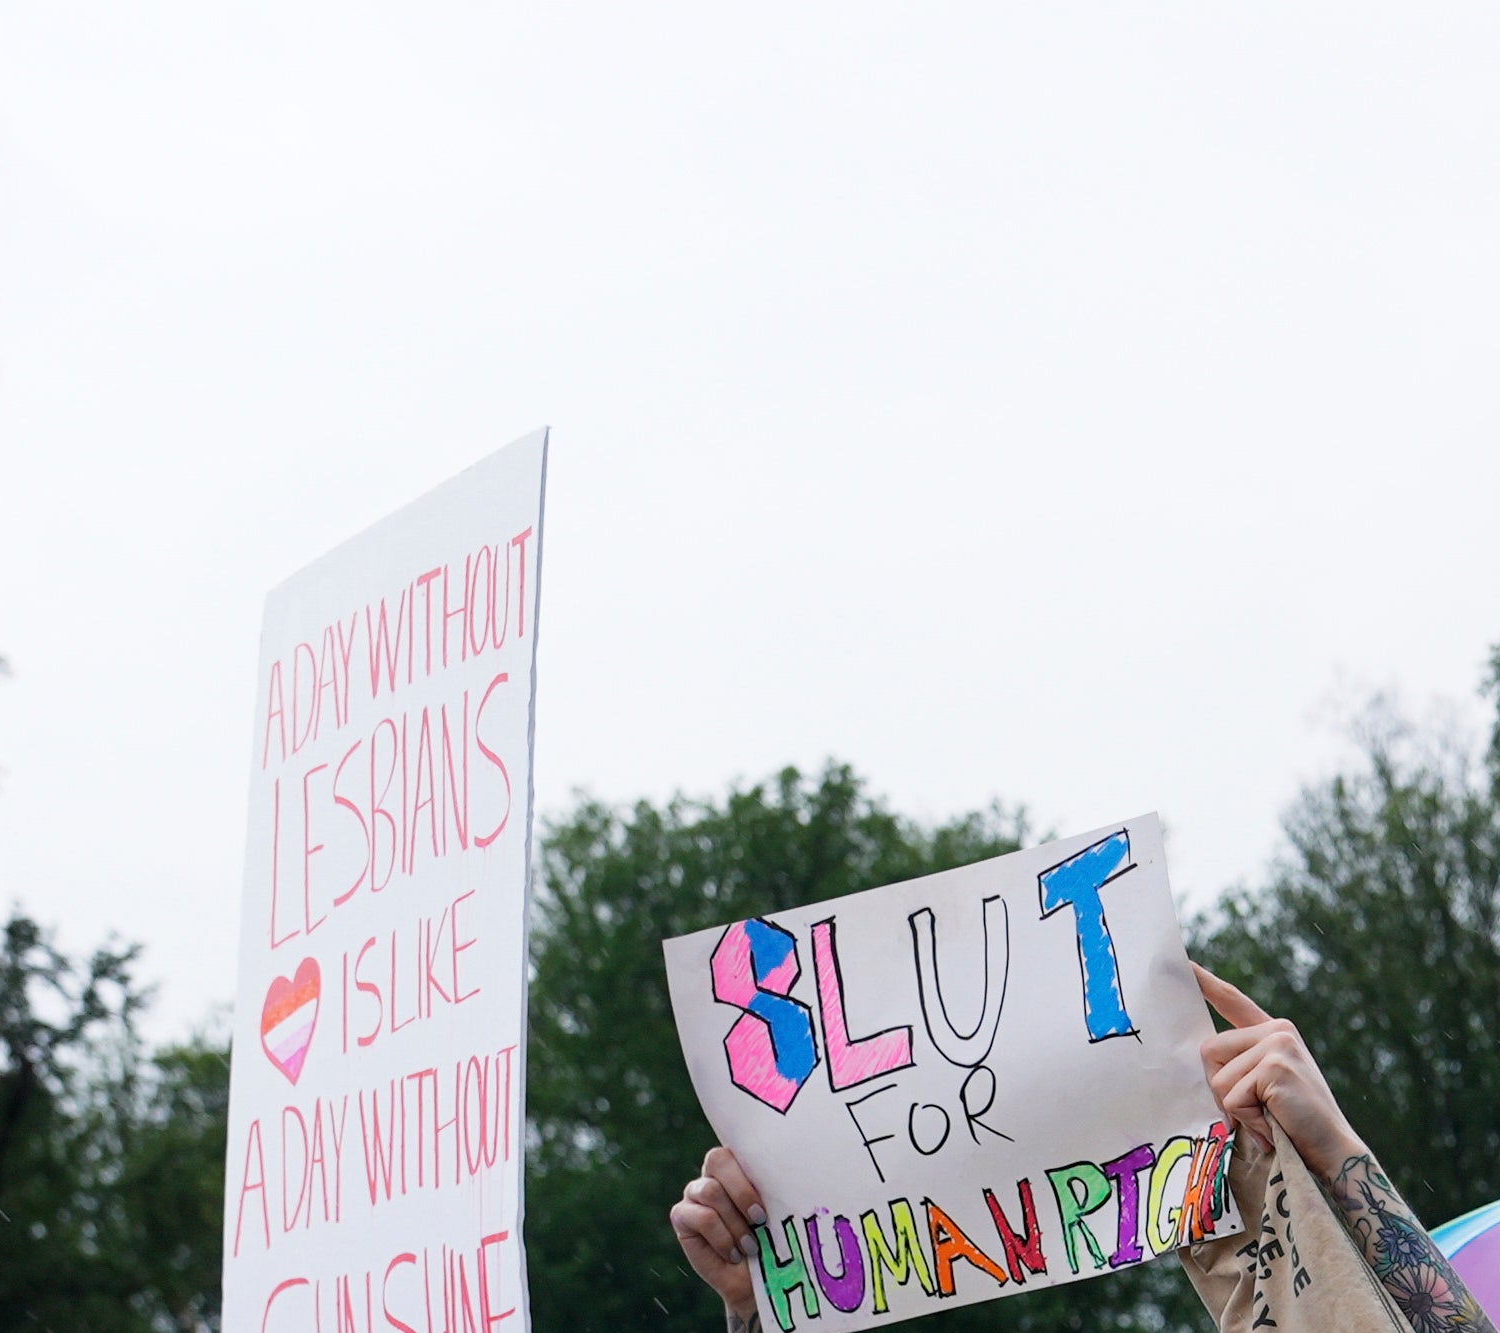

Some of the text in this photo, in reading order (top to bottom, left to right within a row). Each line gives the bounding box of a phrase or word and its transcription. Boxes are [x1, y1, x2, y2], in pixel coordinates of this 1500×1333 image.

[263, 527, 533, 769] A DAY WITHOUT
[270, 672, 510, 949] LESBIANS
[709, 828, 1142, 1115] SLUT
[234, 1045, 517, 1257] A DAY WITHOUT
[846, 1064, 1015, 1183] FOR
[750, 1178, 1047, 1332] HUMAN
